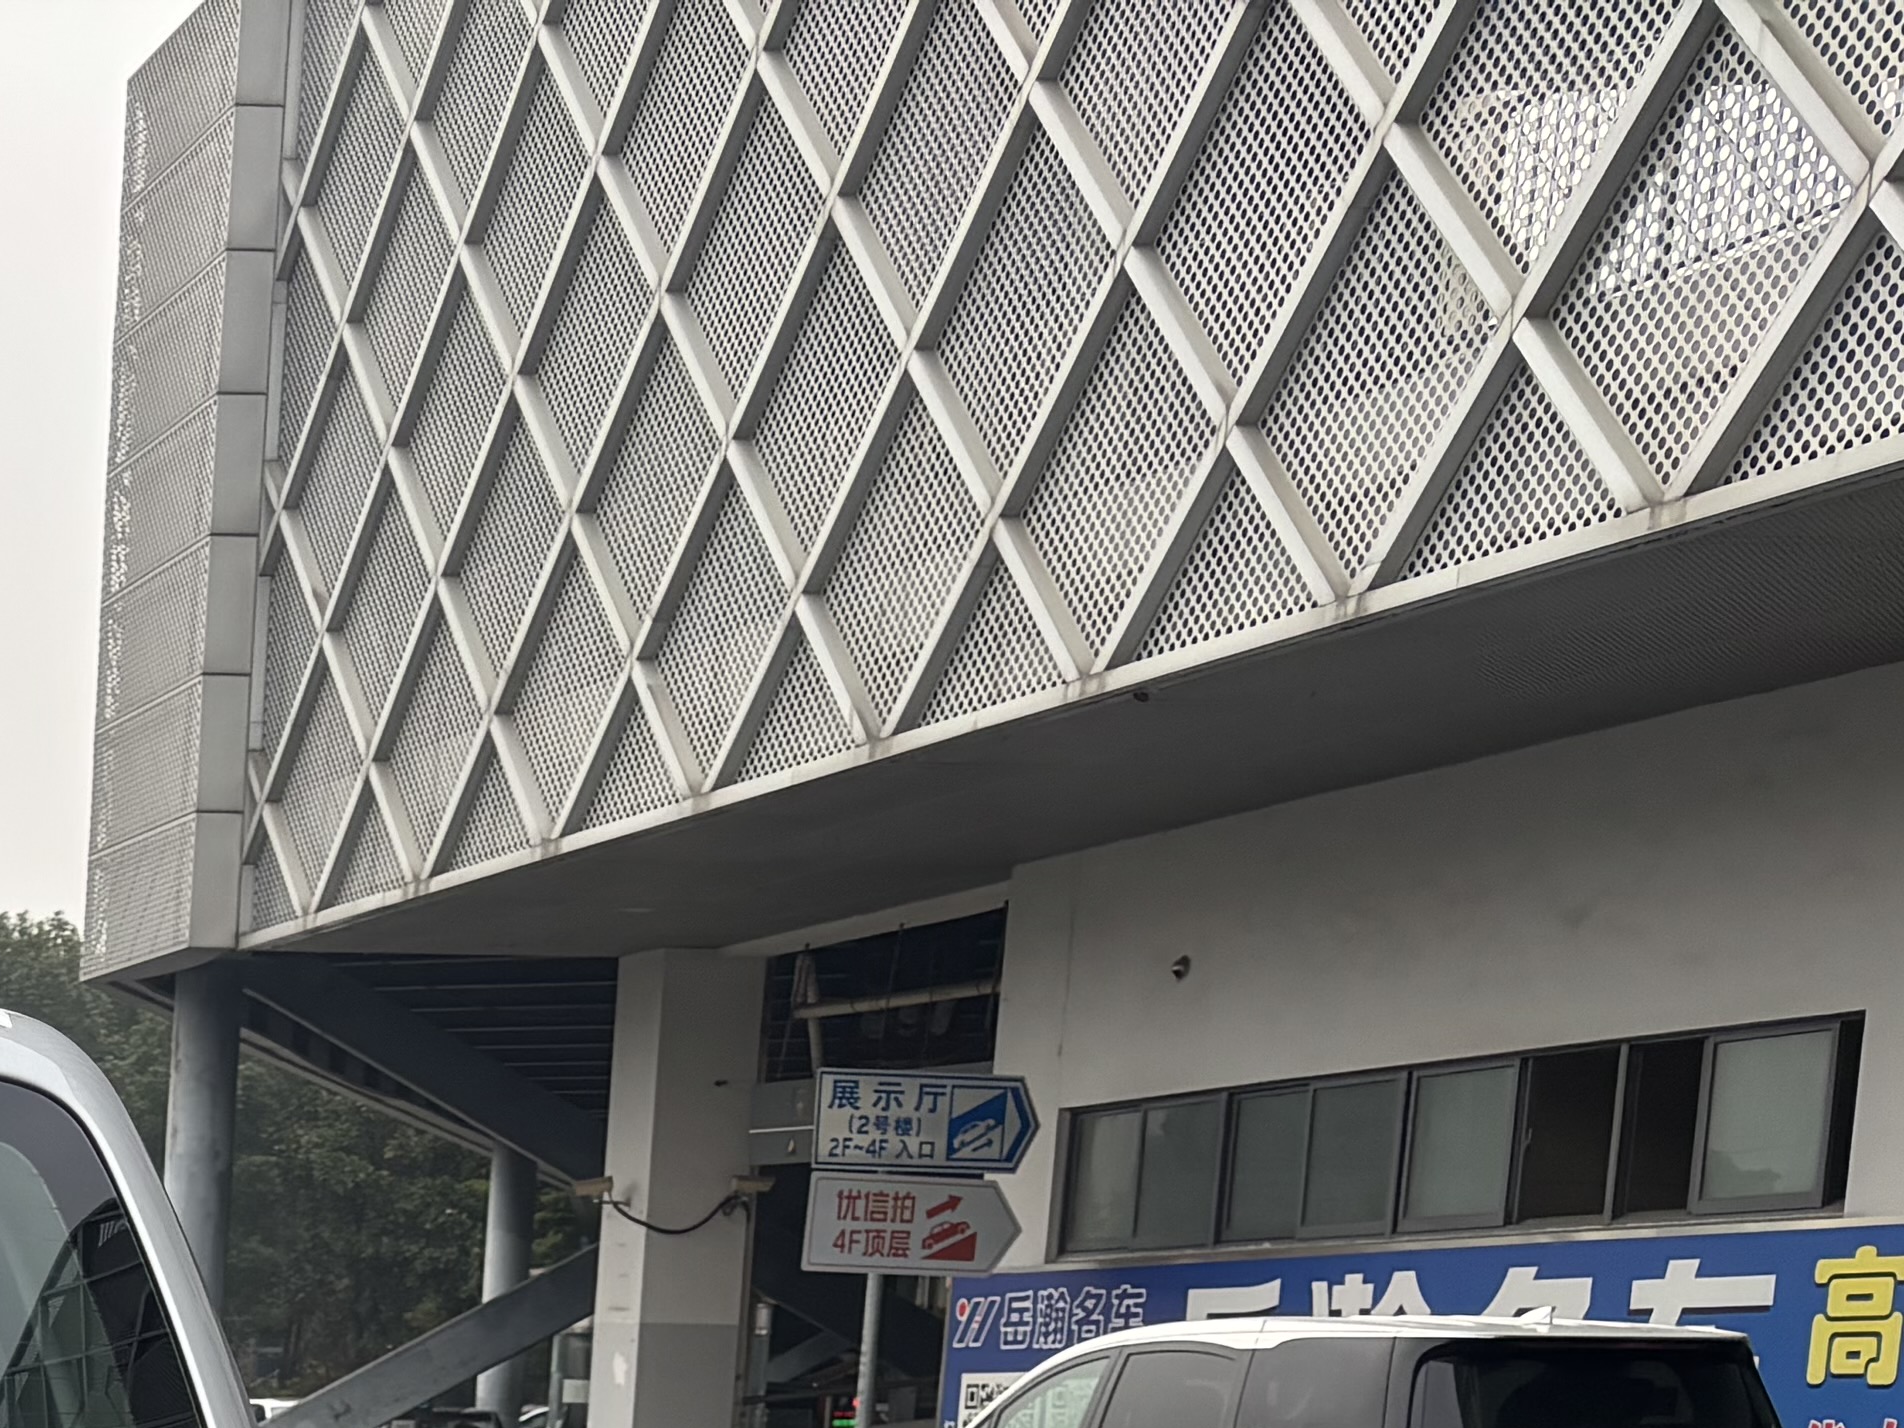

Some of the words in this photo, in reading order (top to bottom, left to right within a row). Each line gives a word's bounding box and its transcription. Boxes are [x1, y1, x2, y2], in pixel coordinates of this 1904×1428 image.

[828, 1080, 948, 1113] 展示厅
[895, 1139, 935, 1159] 入口
[837, 1189, 916, 1223] 优信拍
[832, 1229, 911, 1258] 4F顶层
[1000, 1285, 1147, 1350] 岳瀚名车
[1806, 1245, 1904, 1387] 高
